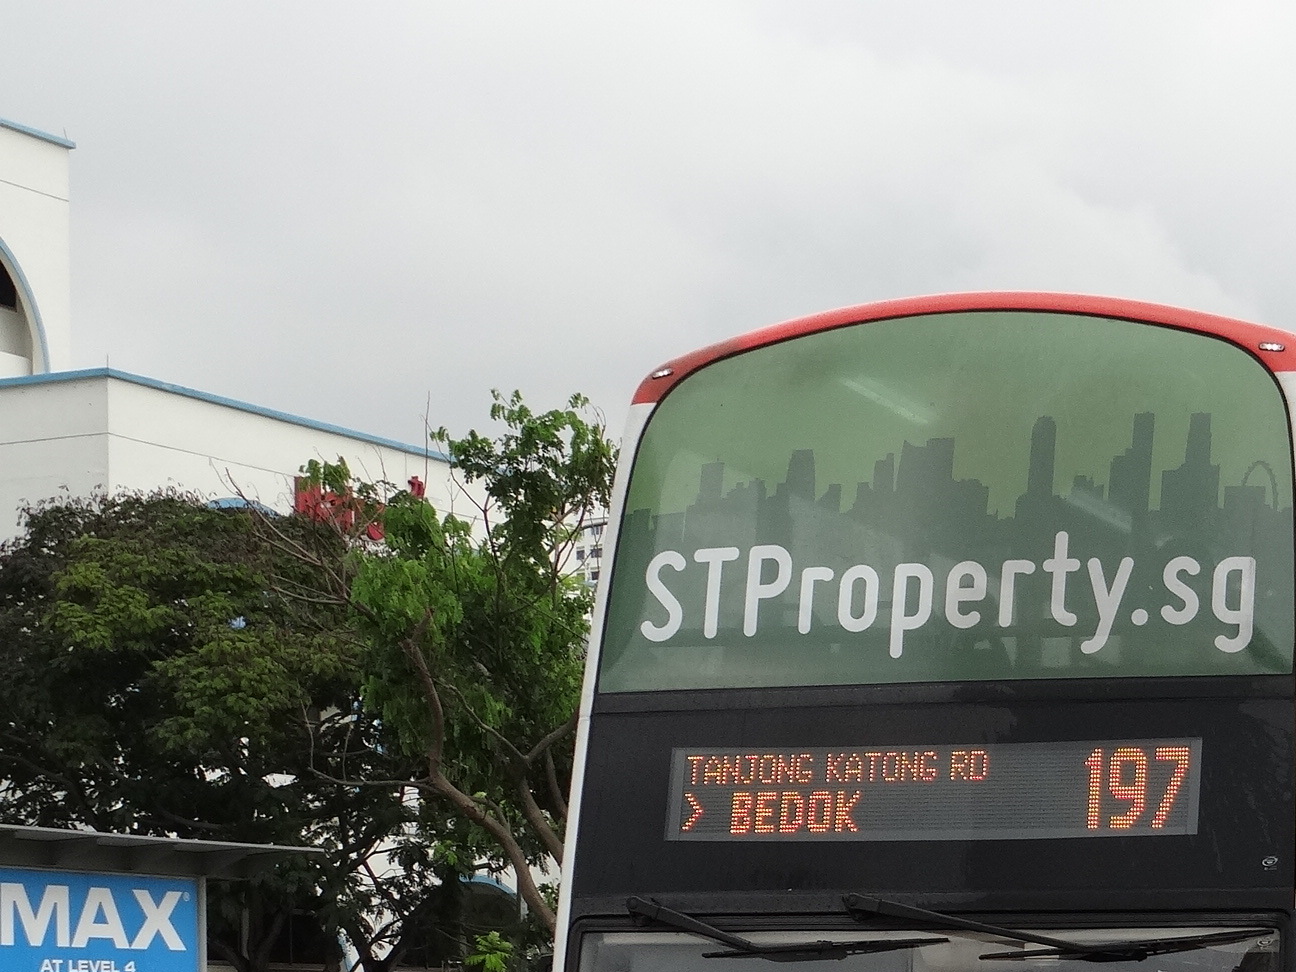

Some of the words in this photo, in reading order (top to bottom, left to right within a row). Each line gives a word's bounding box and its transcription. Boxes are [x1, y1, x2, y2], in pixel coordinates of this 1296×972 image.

[640, 531, 1257, 659] STProperty.sg
[687, 753, 813, 785] TANJONG
[825, 751, 937, 783] KATONG
[950, 750, 988, 781] RD
[1084, 746, 1190, 830] 197
[729, 790, 861, 833] BEDOK
[40, 959, 63, 972] AT
